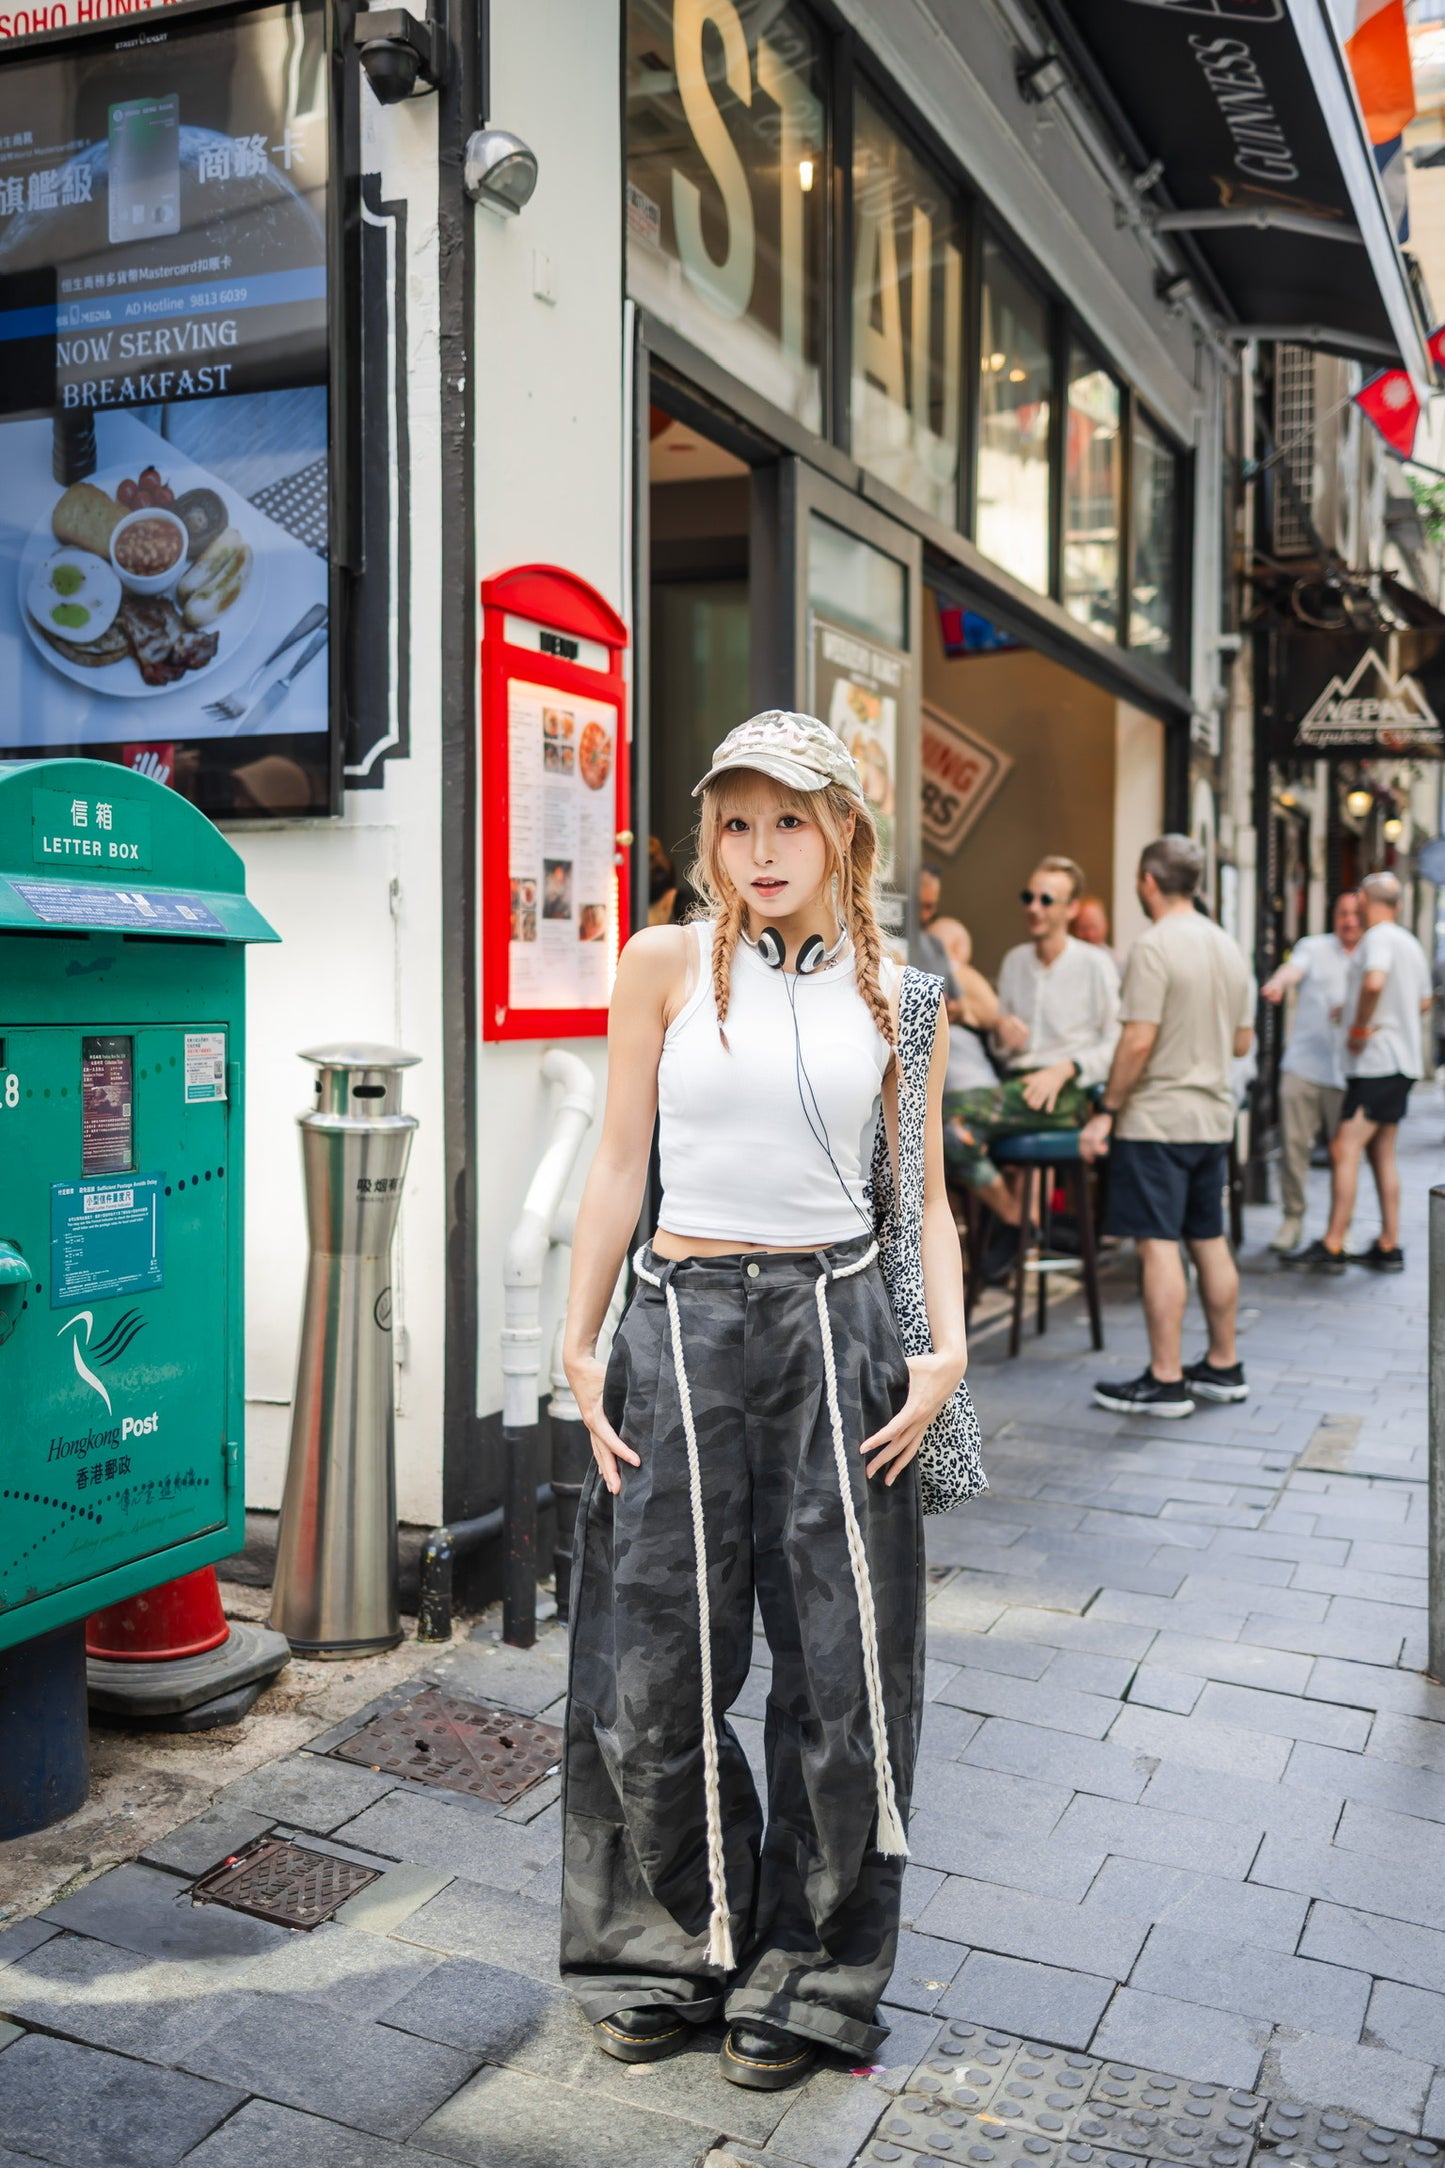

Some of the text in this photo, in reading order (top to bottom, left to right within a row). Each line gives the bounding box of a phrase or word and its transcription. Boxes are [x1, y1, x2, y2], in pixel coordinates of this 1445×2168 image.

[0, 4, 66, 38] SOHO
[1187, 34, 1299, 181] GUINNESS
[199, 129, 305, 184] 商務卡
[125, 303, 141, 316] AD
[144, 297, 184, 314] Hotline
[190, 292, 217, 308] 9813
[220, 288, 247, 304] 6039
[56, 320, 239, 368] NOW SERVING
[63, 364, 232, 408] BREAKFAST
[1316, 699, 1425, 722] NEPAL
[132, 752, 170, 784] illy
[70, 799, 113, 830] 信箱
[43, 837, 139, 860] LETTER BOX
[47, 1411, 158, 1462] Hongkong Post
[76, 1454, 131, 1490] 香港郵政
